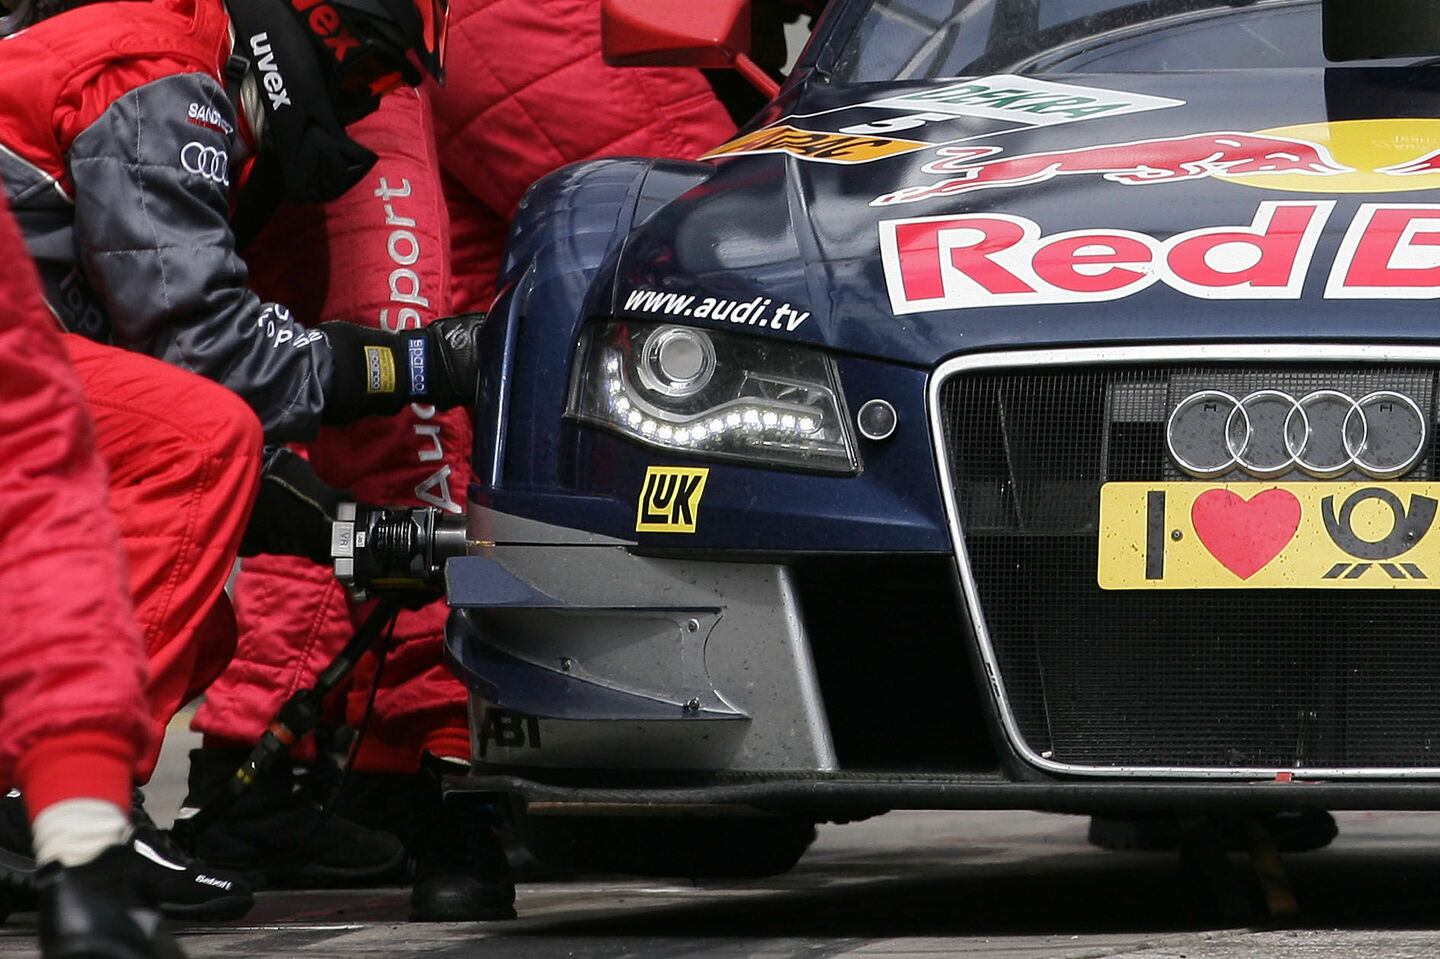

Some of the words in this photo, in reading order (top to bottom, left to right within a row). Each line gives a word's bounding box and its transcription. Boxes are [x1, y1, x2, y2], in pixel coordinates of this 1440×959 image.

[250, 32, 291, 111] uvex
[901, 84, 1132, 119] DEKRA
[376, 176, 430, 335] Sport
[894, 206, 1318, 301] Red
[623, 287, 810, 333] www.audi.tv
[409, 339, 426, 392] sparco
[1145, 490, 1167, 581] I
[479, 708, 541, 755] ABT
